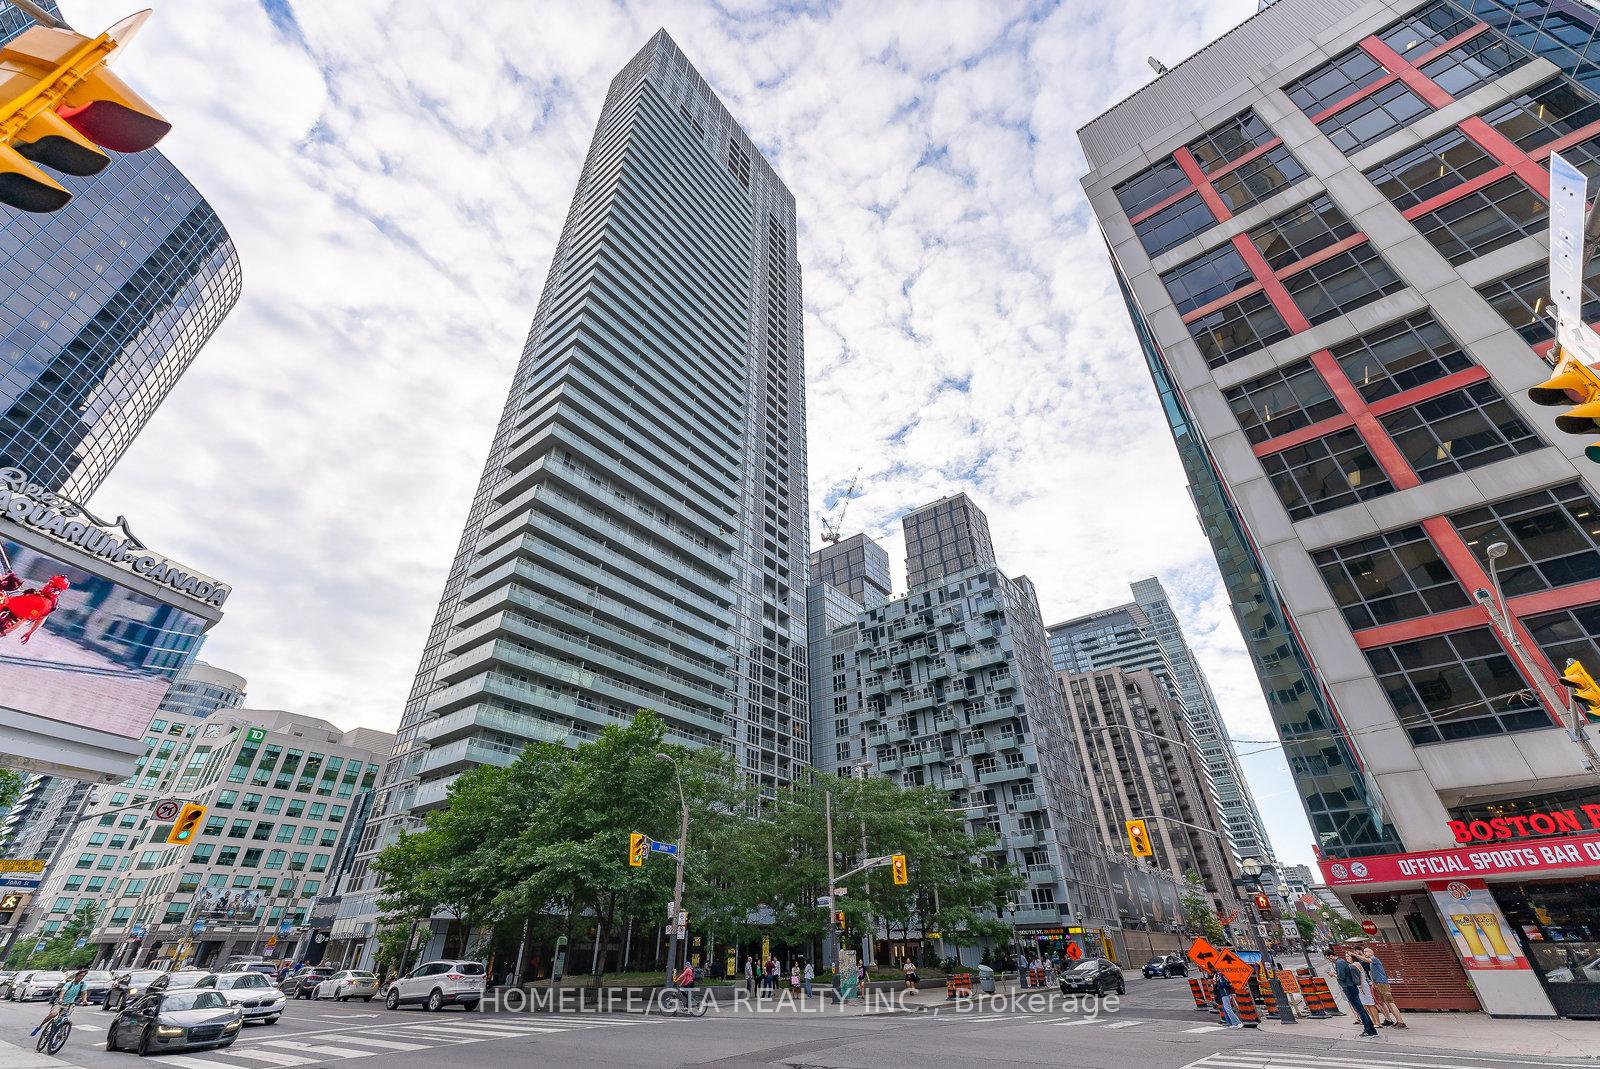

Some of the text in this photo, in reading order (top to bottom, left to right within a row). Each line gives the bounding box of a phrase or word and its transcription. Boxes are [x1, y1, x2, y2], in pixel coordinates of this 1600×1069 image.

[0, 489, 130, 563] AQUARIUM
[133, 556, 226, 606] CANADA
[251, 729, 264, 740] TD
[1447, 809, 1583, 844] BOSTON
[1398, 854, 1470, 876] OFFICIAL
[1469, 848, 1540, 870] SPORTS
[1539, 844, 1583, 864] BAR
[1285, 927, 1297, 936] 30
